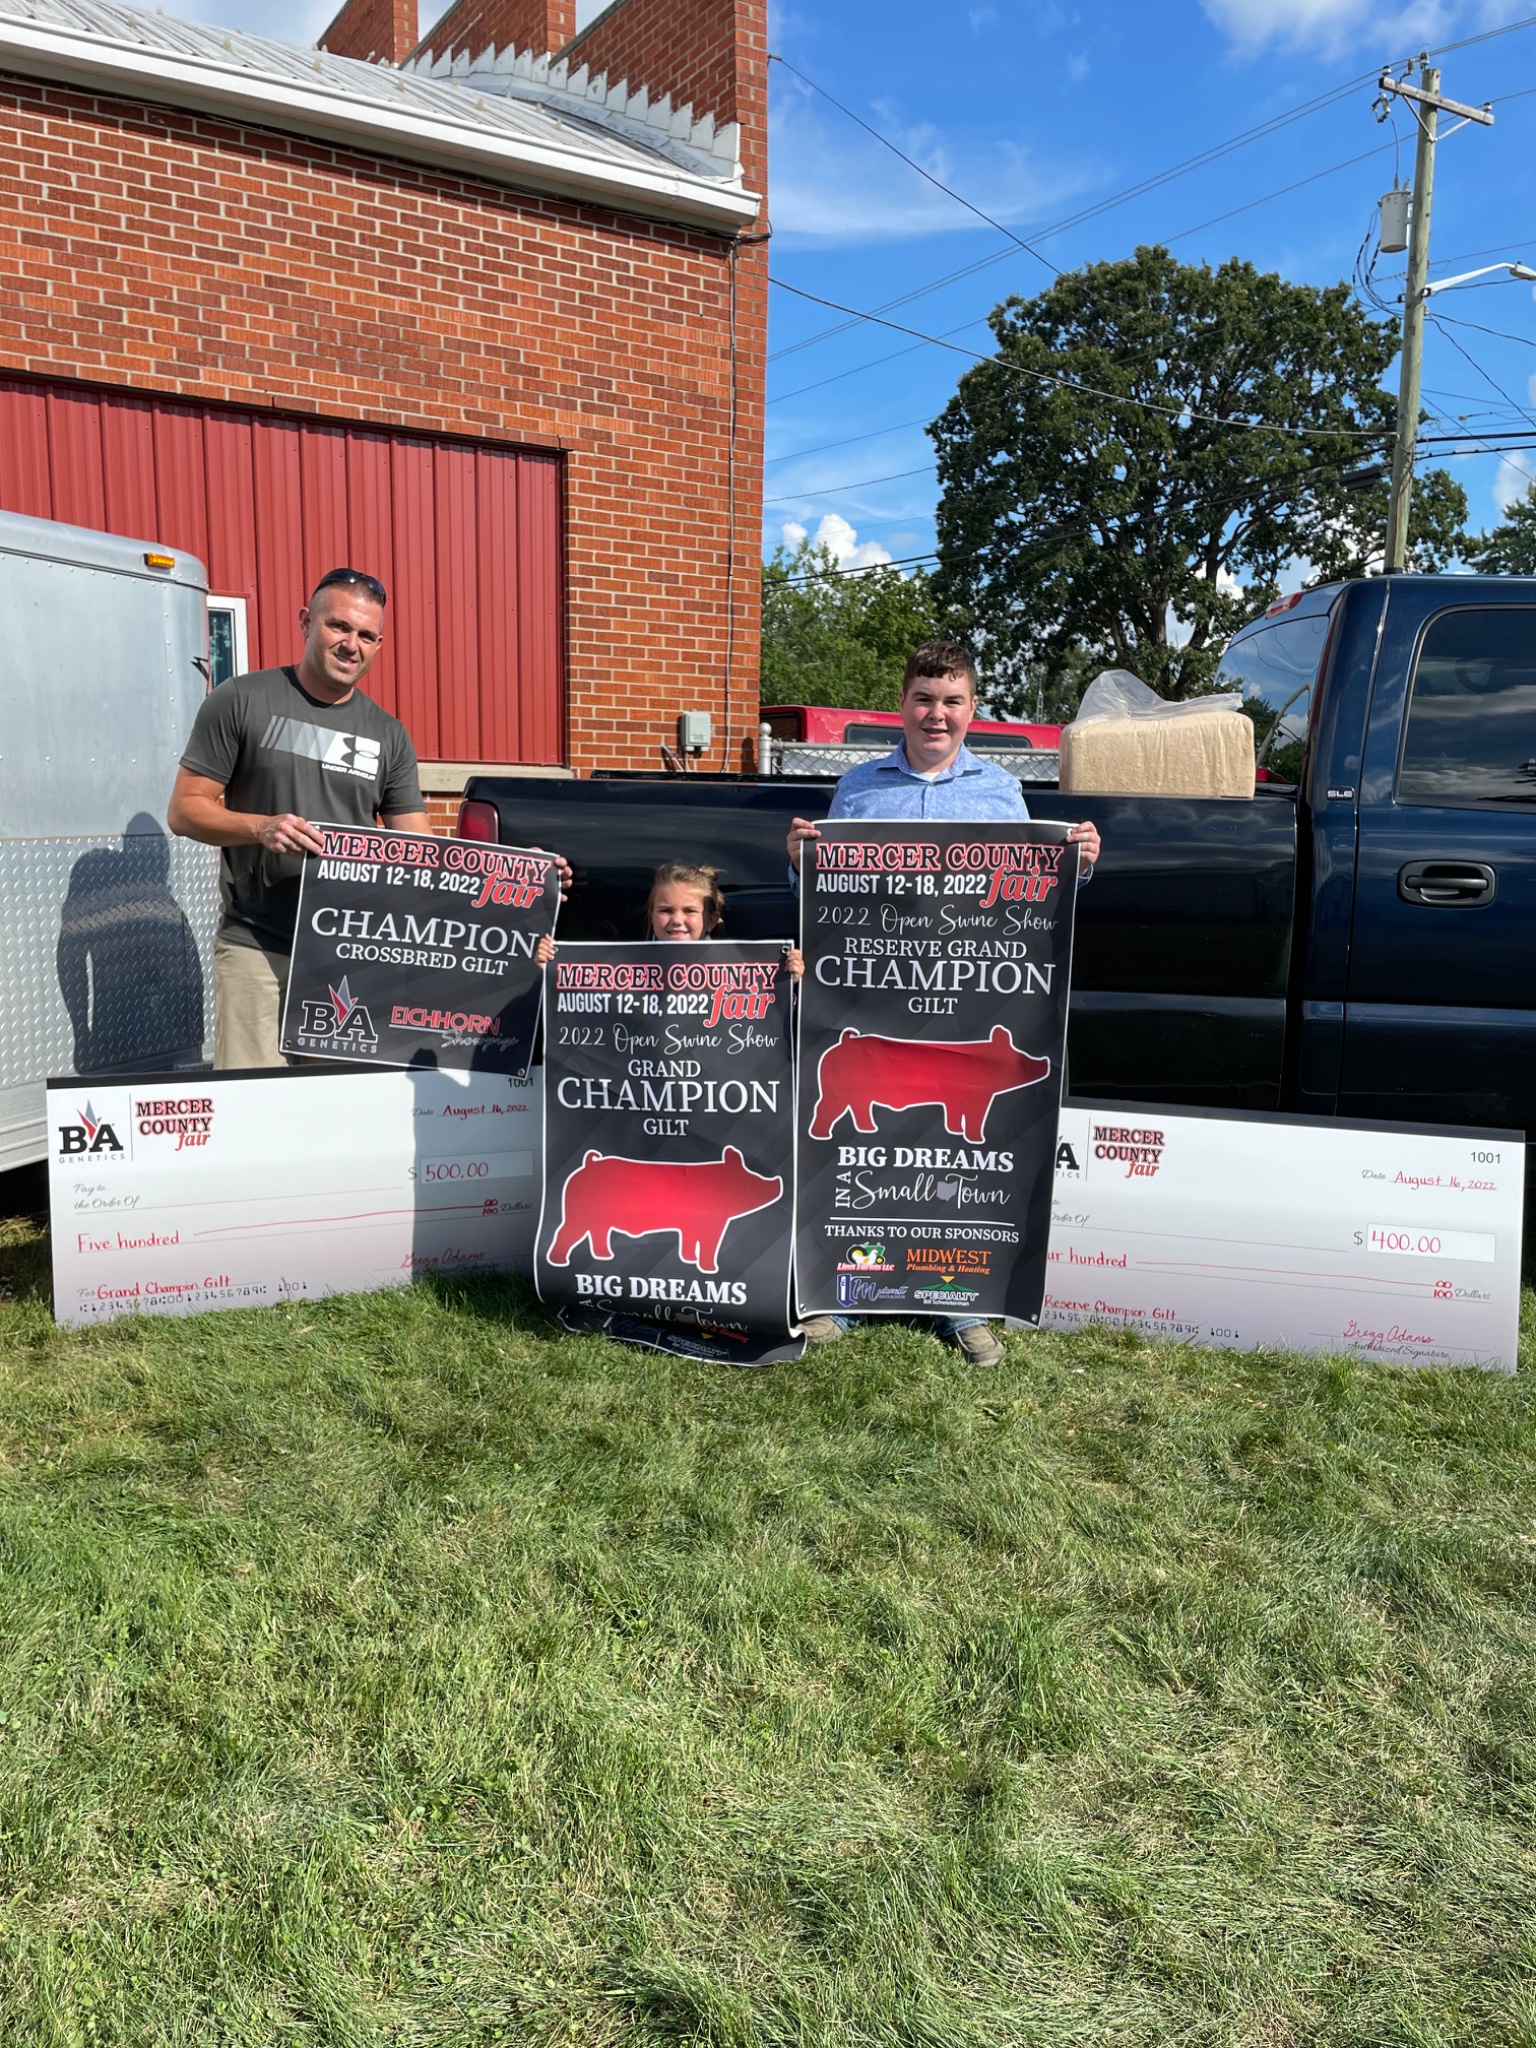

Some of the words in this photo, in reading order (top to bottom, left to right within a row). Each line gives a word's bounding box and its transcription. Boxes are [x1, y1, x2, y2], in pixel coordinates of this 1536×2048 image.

[322, 763, 347, 773] UNDER
[348, 769, 376, 781] ARMOUR
[320, 831, 440, 867] MERCER
[444, 845, 552, 884] COUNTY
[816, 843, 941, 871] MERCER
[946, 843, 1064, 872] COUNTY
[318, 860, 381, 884] AUGUST
[386, 867, 435, 890] 12-18,
[440, 872, 480, 895] 2022
[816, 874, 880, 893] AUGUST
[887, 874, 939, 897] 12-18,
[943, 874, 986, 895] 2022
[979, 865, 1058, 908] fair
[471, 874, 543, 909] fair
[817, 906, 871, 925] 2022
[881, 904, 933, 935] Open
[938, 905, 998, 935] Swine
[1003, 905, 1058, 935] Show
[311, 907, 539, 959] CHAMPION
[844, 937, 941, 958] RESERVE
[948, 941, 1027, 958] GRAND
[336, 943, 457, 969] CROSSBRED
[462, 956, 508, 975] GILT
[557, 963, 664, 990] MERCER
[668, 963, 779, 990] COUNTY
[815, 955, 1056, 995] CHAMPION
[557, 993, 611, 1013] AUGUST
[616, 994, 662, 1016] 12-18,
[667, 995, 708, 1014] 2022
[703, 985, 775, 1027] fair
[908, 997, 958, 1015] GILT
[391, 1006, 500, 1035] EICHHORN
[297, 1038, 377, 1053] GENETICS
[559, 1026, 606, 1045] 2022
[613, 1023, 659, 1055] Open
[664, 1024, 721, 1055] Swine
[727, 1024, 779, 1054] Show
[628, 1060, 701, 1077] GRAND
[557, 1077, 780, 1113] CHAMPION
[136, 1098, 214, 1117] MERCER
[412, 1108, 433, 1116] Date
[443, 1104, 484, 1120] August
[507, 1104, 528, 1112] 2022
[139, 1117, 213, 1135] COUNTY
[643, 1119, 689, 1136] GILT
[1093, 1125, 1165, 1146] MERCER
[175, 1131, 211, 1151] fair
[59, 1153, 125, 1164] GENETICS
[837, 1146, 887, 1167] BIG
[893, 1147, 1014, 1172] DREAMS
[1056, 1142, 1080, 1170] A
[1095, 1144, 1163, 1163] COUNTY
[1470, 1152, 1501, 1164] 1001
[425, 1162, 489, 1181] 500.00
[836, 1170, 851, 1184] A
[1125, 1160, 1159, 1178] fair
[1361, 1169, 1386, 1180] Date
[1394, 1171, 1442, 1190] August
[1468, 1180, 1497, 1190] 2022
[74, 1183, 95, 1196] Pay
[835, 1187, 850, 1208] IN
[852, 1170, 937, 1210] Small
[945, 1173, 1011, 1209] Town
[74, 1199, 89, 1209] the
[92, 1197, 121, 1208] Order
[124, 1195, 140, 1209] Of
[501, 1202, 533, 1212] Dollars
[1075, 1214, 1089, 1227] Of
[78, 1233, 111, 1253] Five
[117, 1230, 180, 1249] hundred
[825, 1224, 884, 1237] THANKS
[888, 1227, 907, 1238] TO
[911, 1227, 941, 1239] OUR
[944, 1228, 1019, 1244] SPONSORS
[1353, 1231, 1363, 1245] $
[1372, 1230, 1441, 1254] 400.00
[907, 1247, 991, 1265] MIDWEST
[1047, 1252, 1064, 1261] ur
[1070, 1247, 1126, 1267] hundred
[906, 1265, 946, 1273] Plumbing
[957, 1265, 991, 1275] Heating
[97, 1282, 141, 1300] Grand
[145, 1281, 199, 1299] Champion
[204, 1275, 232, 1288] Gilt
[575, 1274, 623, 1297] BIG
[629, 1277, 747, 1305] DREAMS
[914, 1290, 979, 1301] SPECIALTY
[1433, 1290, 1452, 1298] 100
[1454, 1289, 1492, 1300] Dollars
[1044, 1294, 1090, 1310] Reserve
[1094, 1300, 1146, 1319] Champion
[1152, 1308, 1176, 1320] Gilt
[1343, 1320, 1383, 1349] Gregg
[1387, 1325, 1435, 1343] Adams
[1403, 1346, 1449, 1359] Signature
